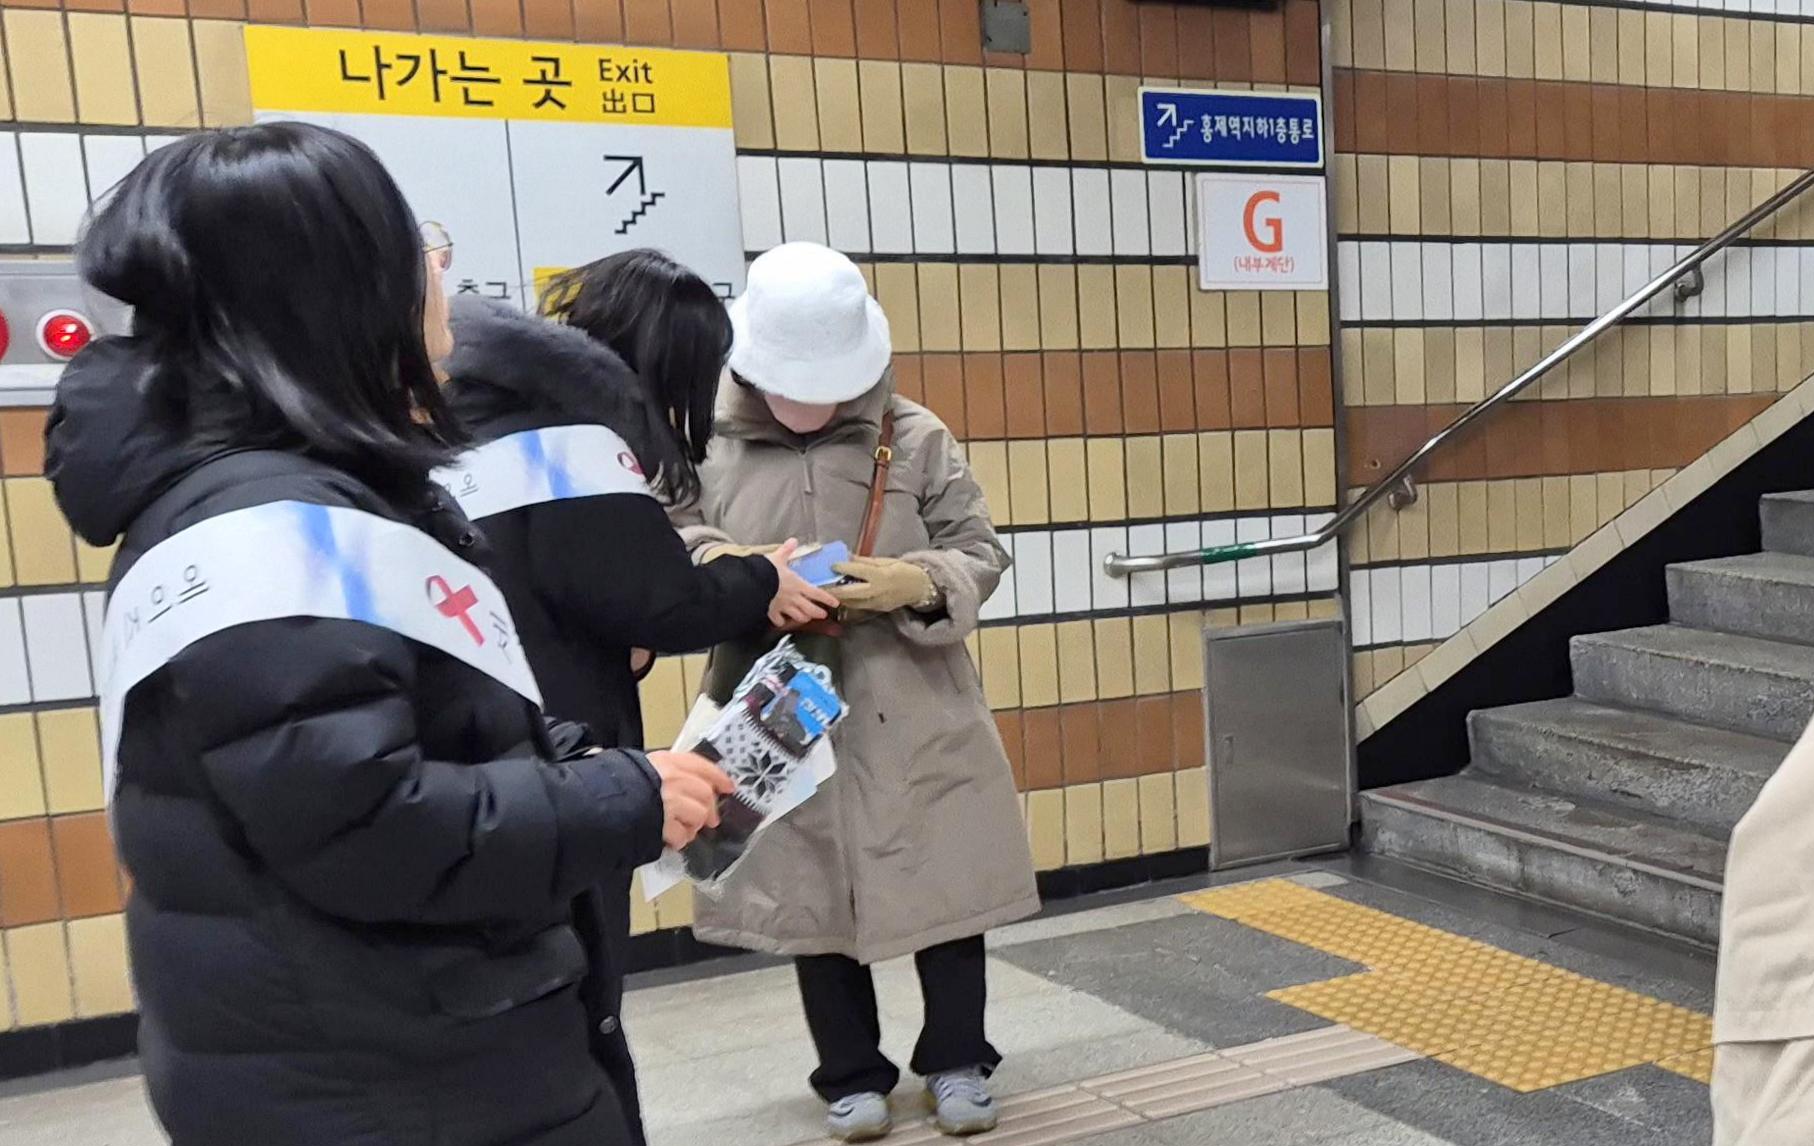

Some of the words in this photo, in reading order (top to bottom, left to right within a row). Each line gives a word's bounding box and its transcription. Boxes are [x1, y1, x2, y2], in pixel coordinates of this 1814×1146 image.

[339, 45, 502, 107] 나가는
[522, 56, 572, 110] 곳
[598, 58, 654, 85] Exit
[602, 89, 656, 114] 出口
[1200, 113, 1315, 144] 홍제역지하1층통로
[1242, 190, 1283, 253] G
